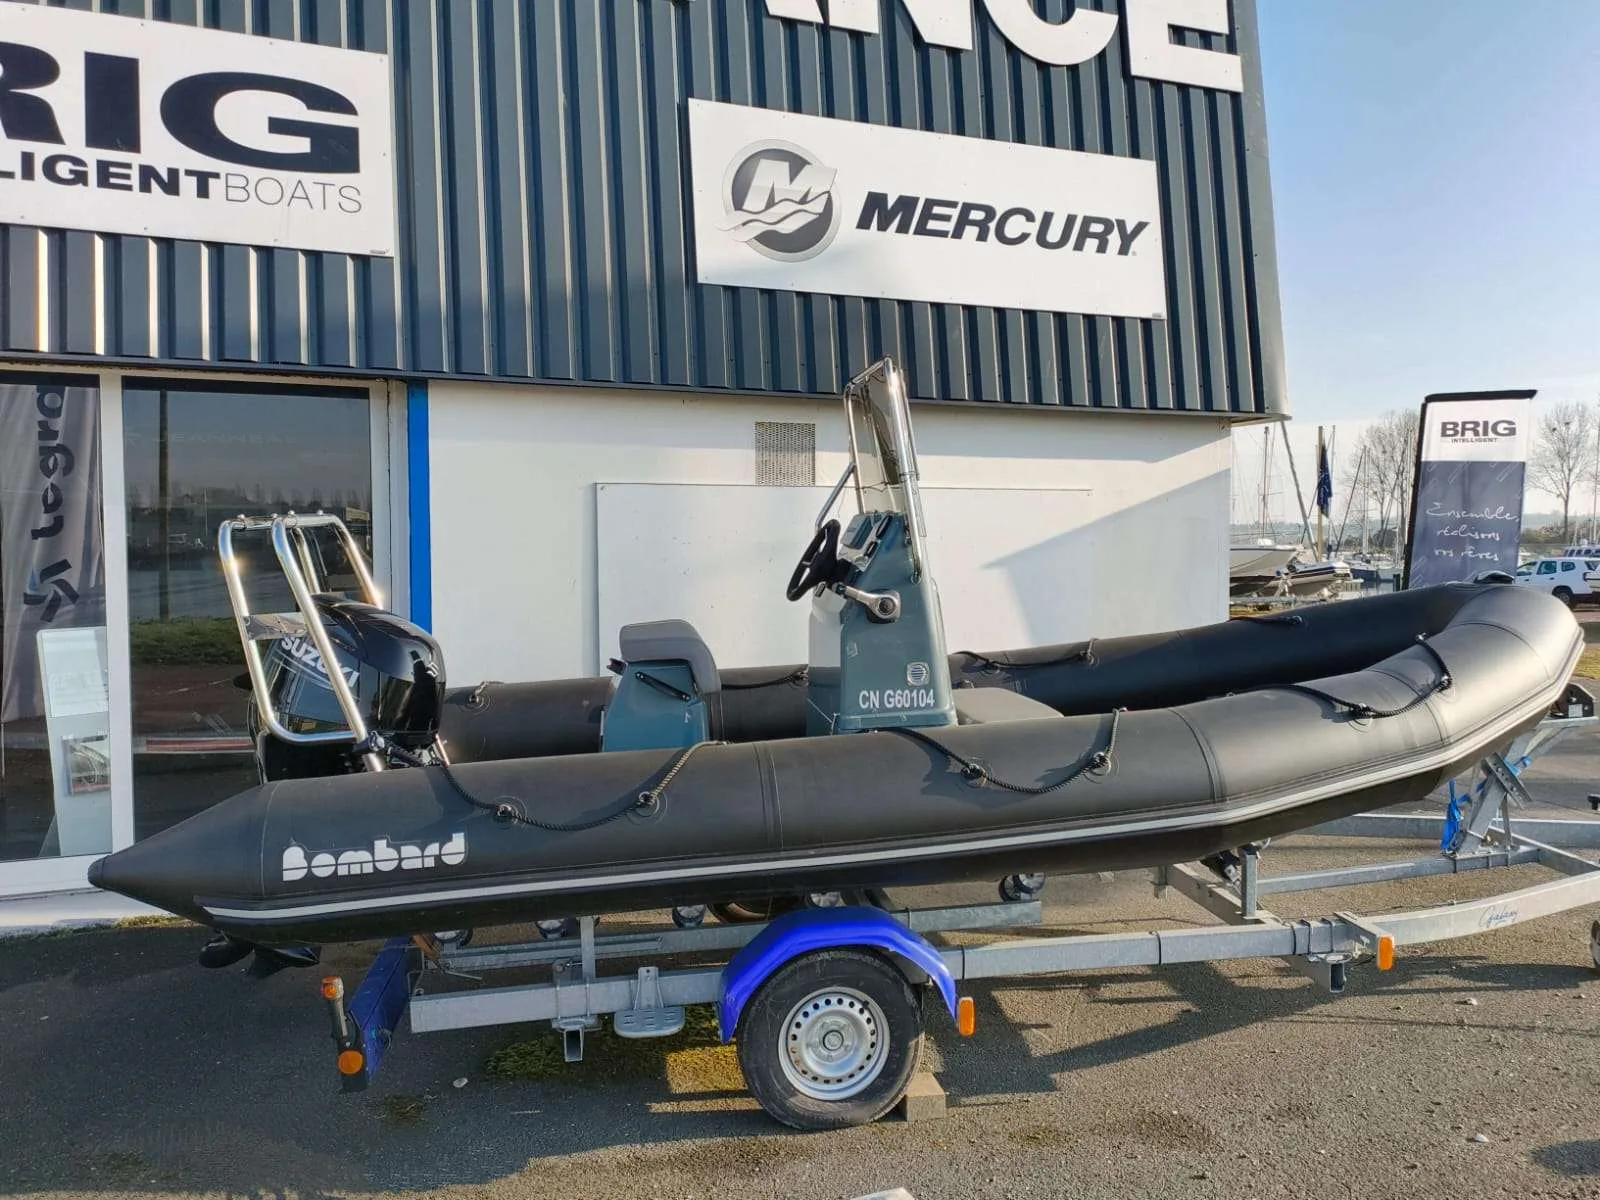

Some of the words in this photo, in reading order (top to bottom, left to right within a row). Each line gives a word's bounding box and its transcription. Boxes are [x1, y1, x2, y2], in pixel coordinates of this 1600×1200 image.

[856, 191, 1149, 257] MERCURY
[1440, 420, 1517, 437] BRIG
[859, 690, 879, 708] CN
[884, 689, 935, 708] G60104
[282, 832, 466, 881] Bombard
